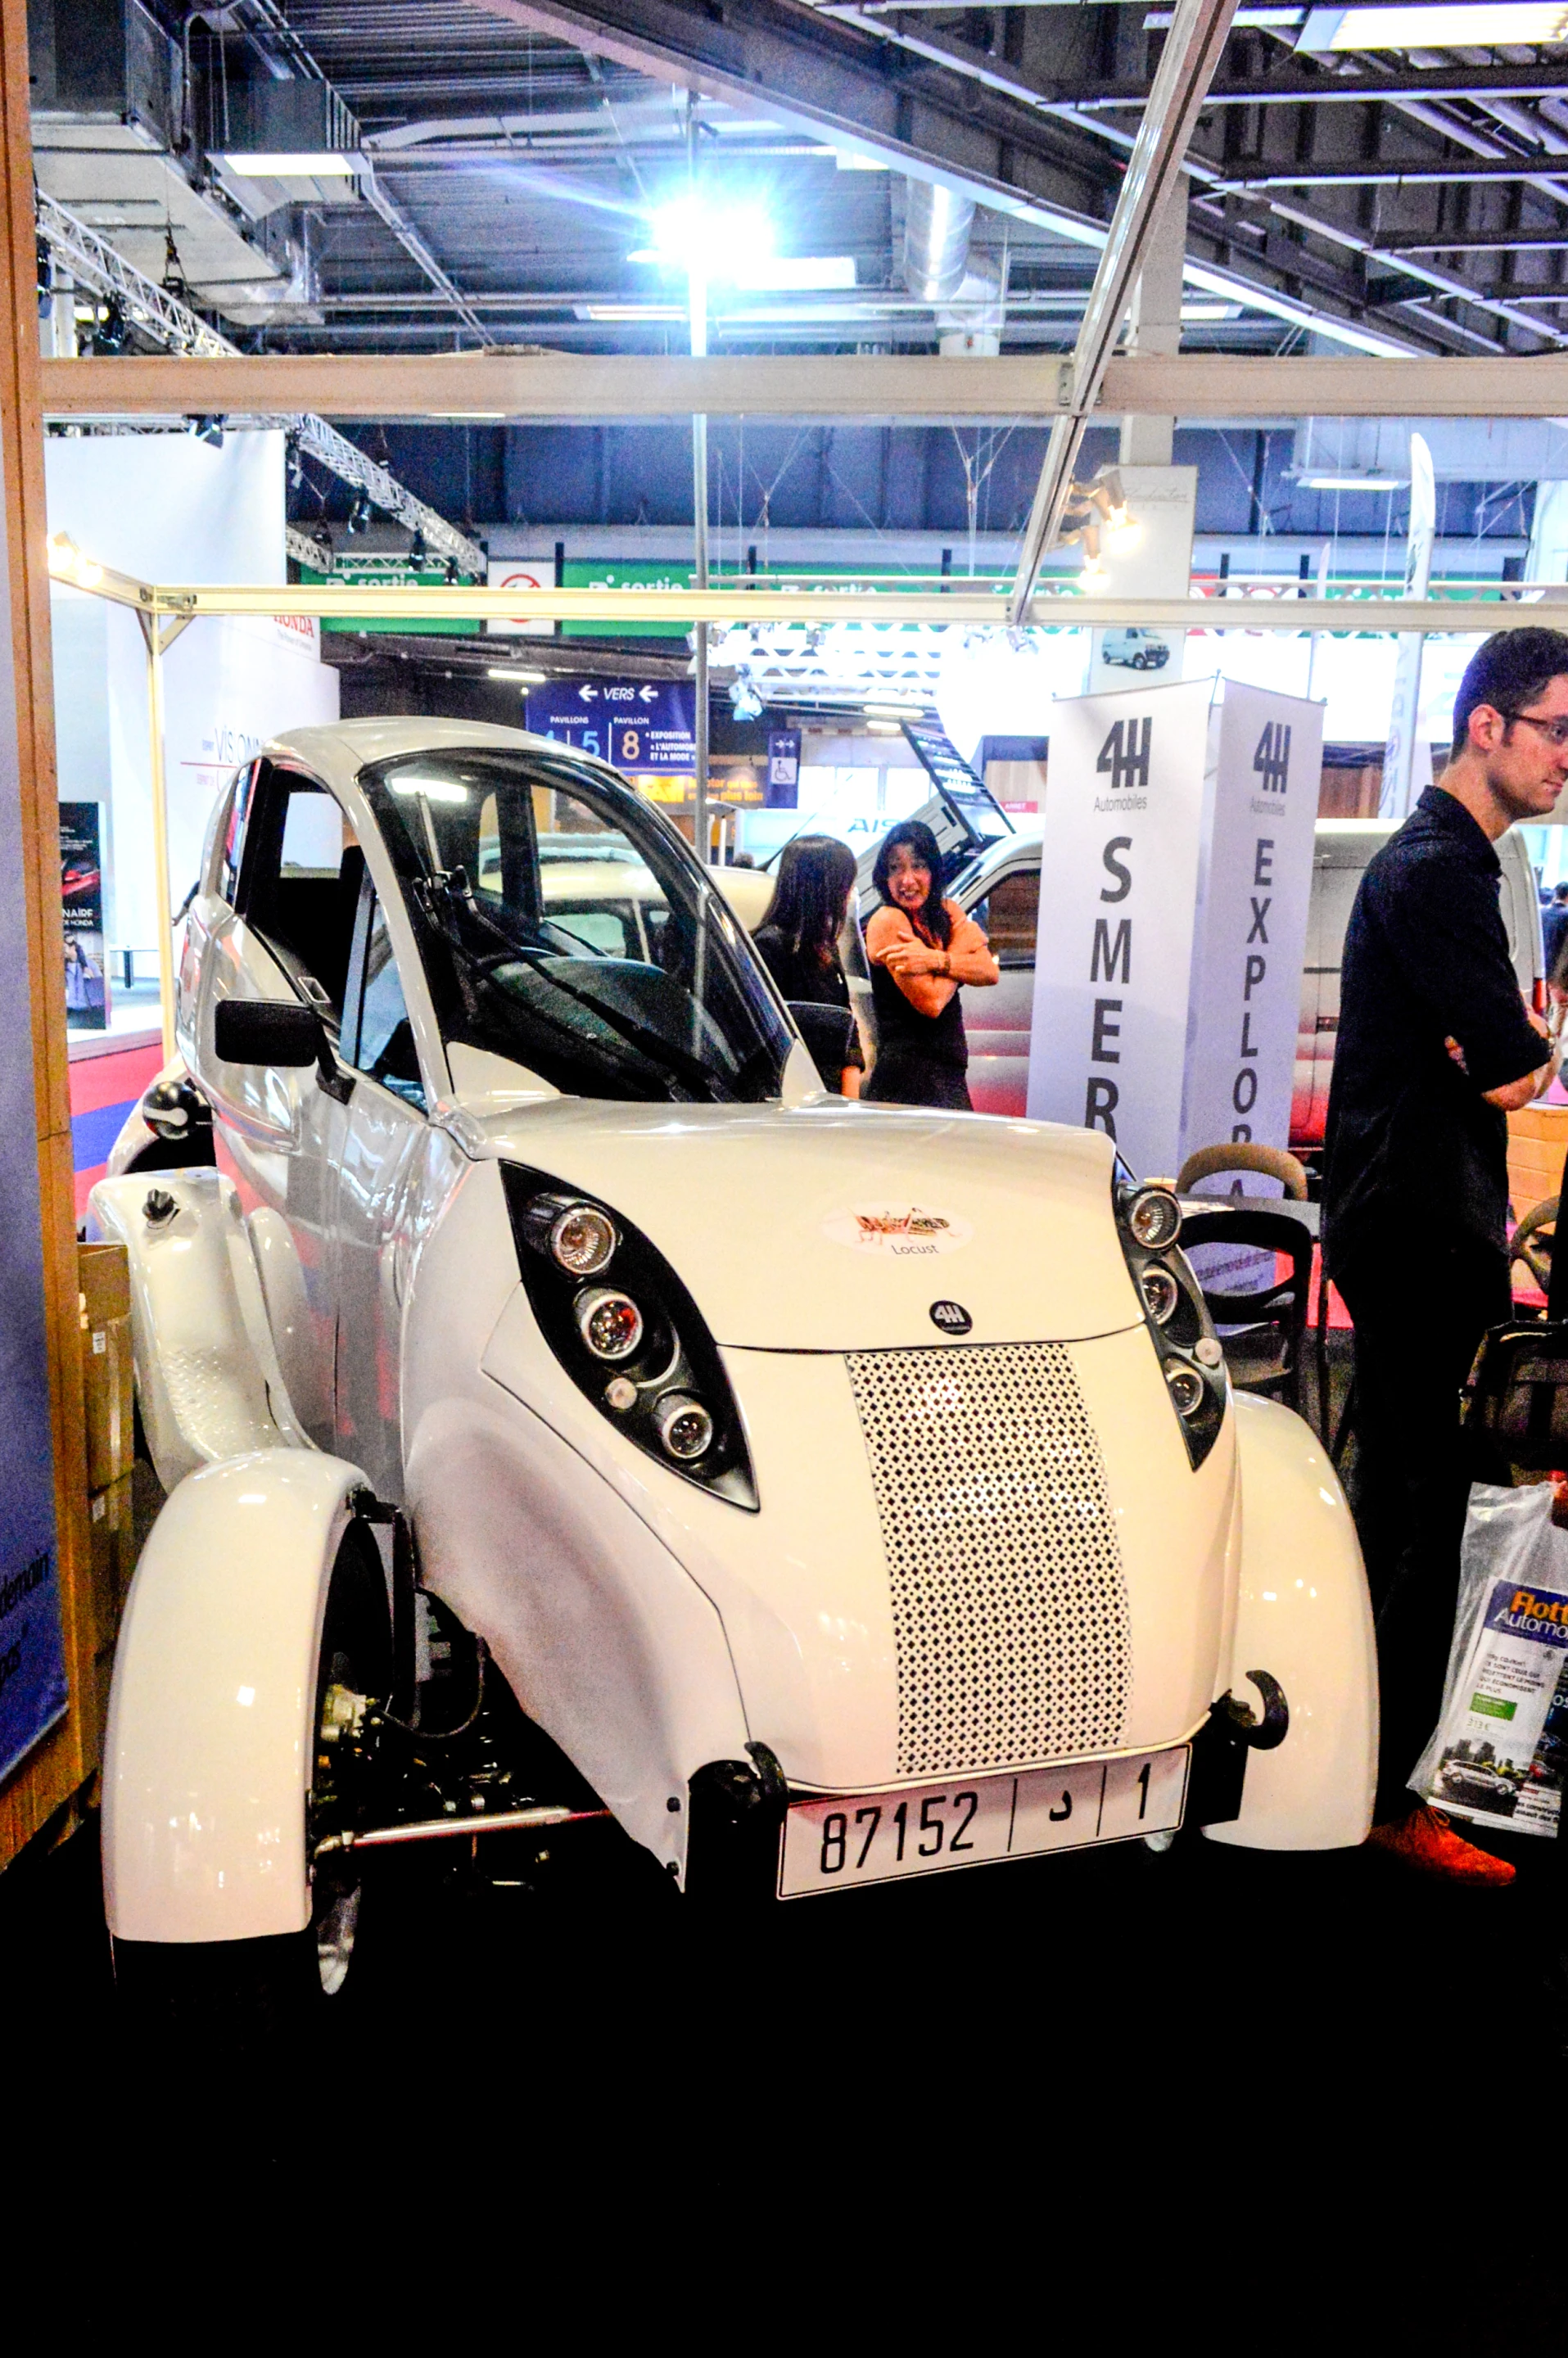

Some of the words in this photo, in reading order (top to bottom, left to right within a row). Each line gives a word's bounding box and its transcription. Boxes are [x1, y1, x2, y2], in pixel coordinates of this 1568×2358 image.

[603, 687, 635, 700] VERS
[549, 716, 590, 724] PAVILLONS
[613, 716, 650, 725] PAVILLON
[650, 730, 691, 740] EXPOSITION
[581, 730, 600, 757] 5
[622, 730, 640, 761] 8
[650, 752, 659, 761] ET
[660, 752, 669, 761] LA
[670, 752, 690, 761] MODE
[1096, 716, 1152, 788] 4H
[1253, 720, 1291, 793] 4H
[1093, 794, 1149, 813] Automobiles
[891, 1244, 940, 1255] Locust
[820, 1791, 980, 1875] 87152
